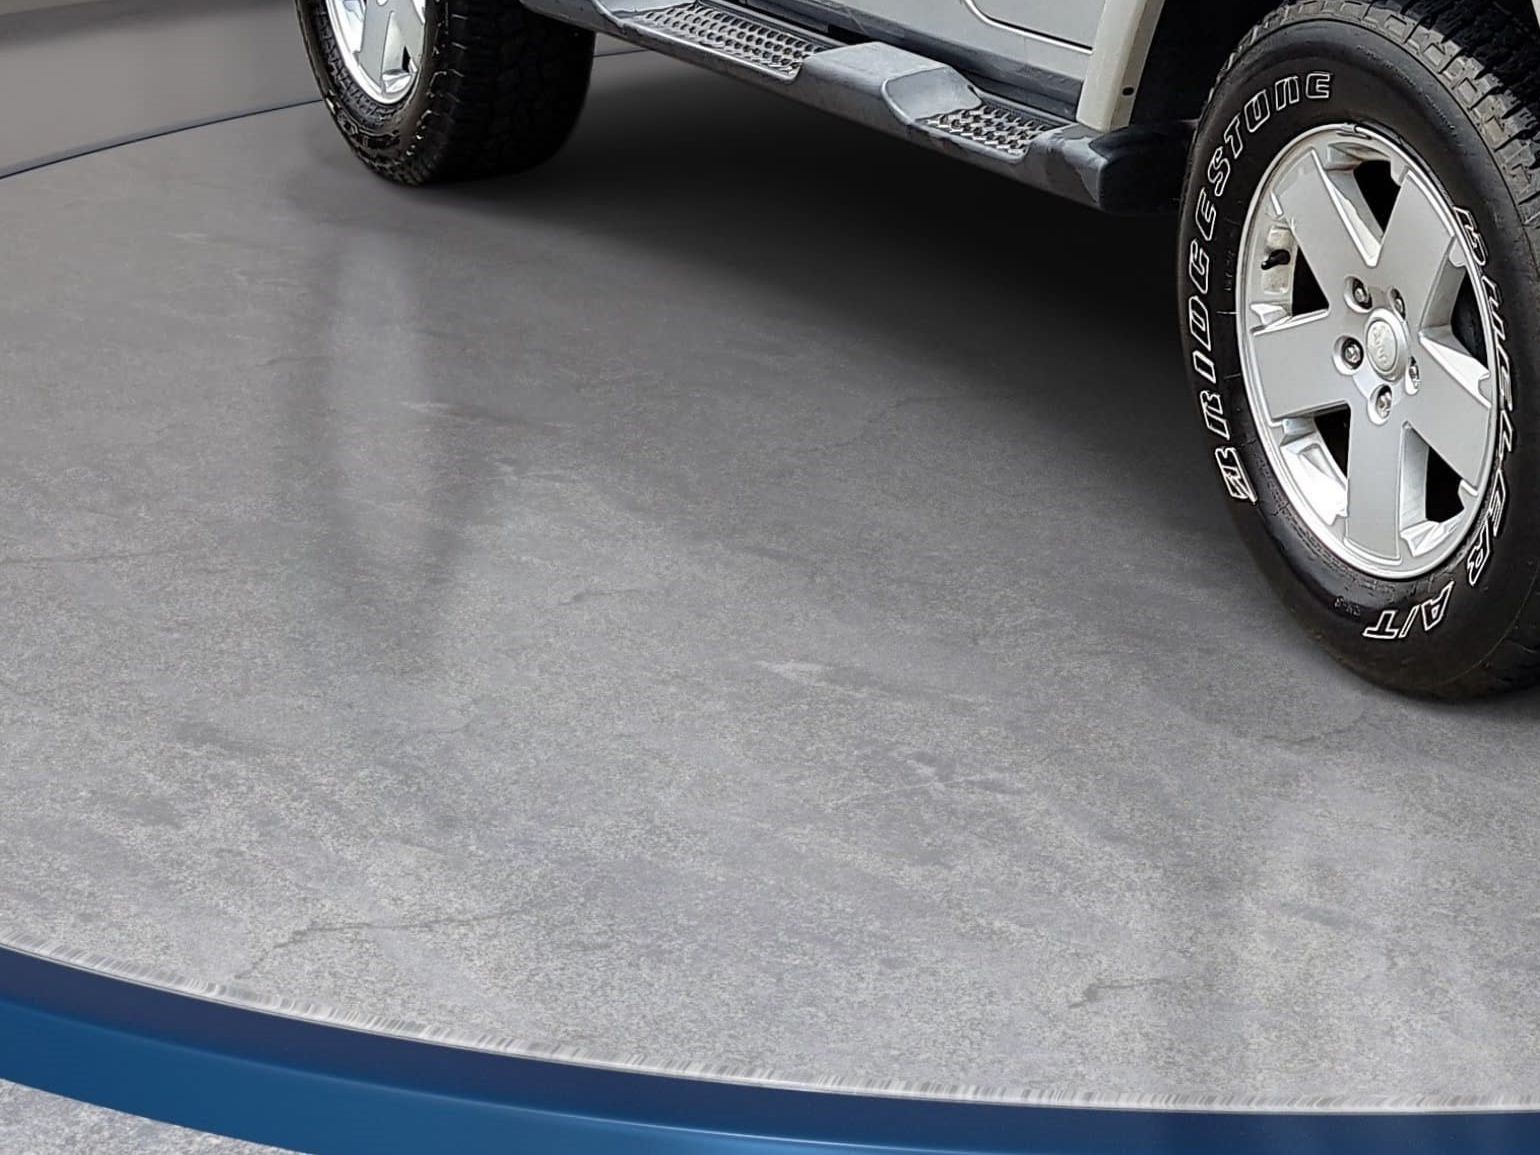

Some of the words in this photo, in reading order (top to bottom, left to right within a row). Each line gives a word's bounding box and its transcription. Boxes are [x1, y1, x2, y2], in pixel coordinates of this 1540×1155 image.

[1188, 72, 1332, 504] BRIDGESTONE
[1452, 206, 1515, 586] DUELER
[1362, 580, 1455, 639] A/T
